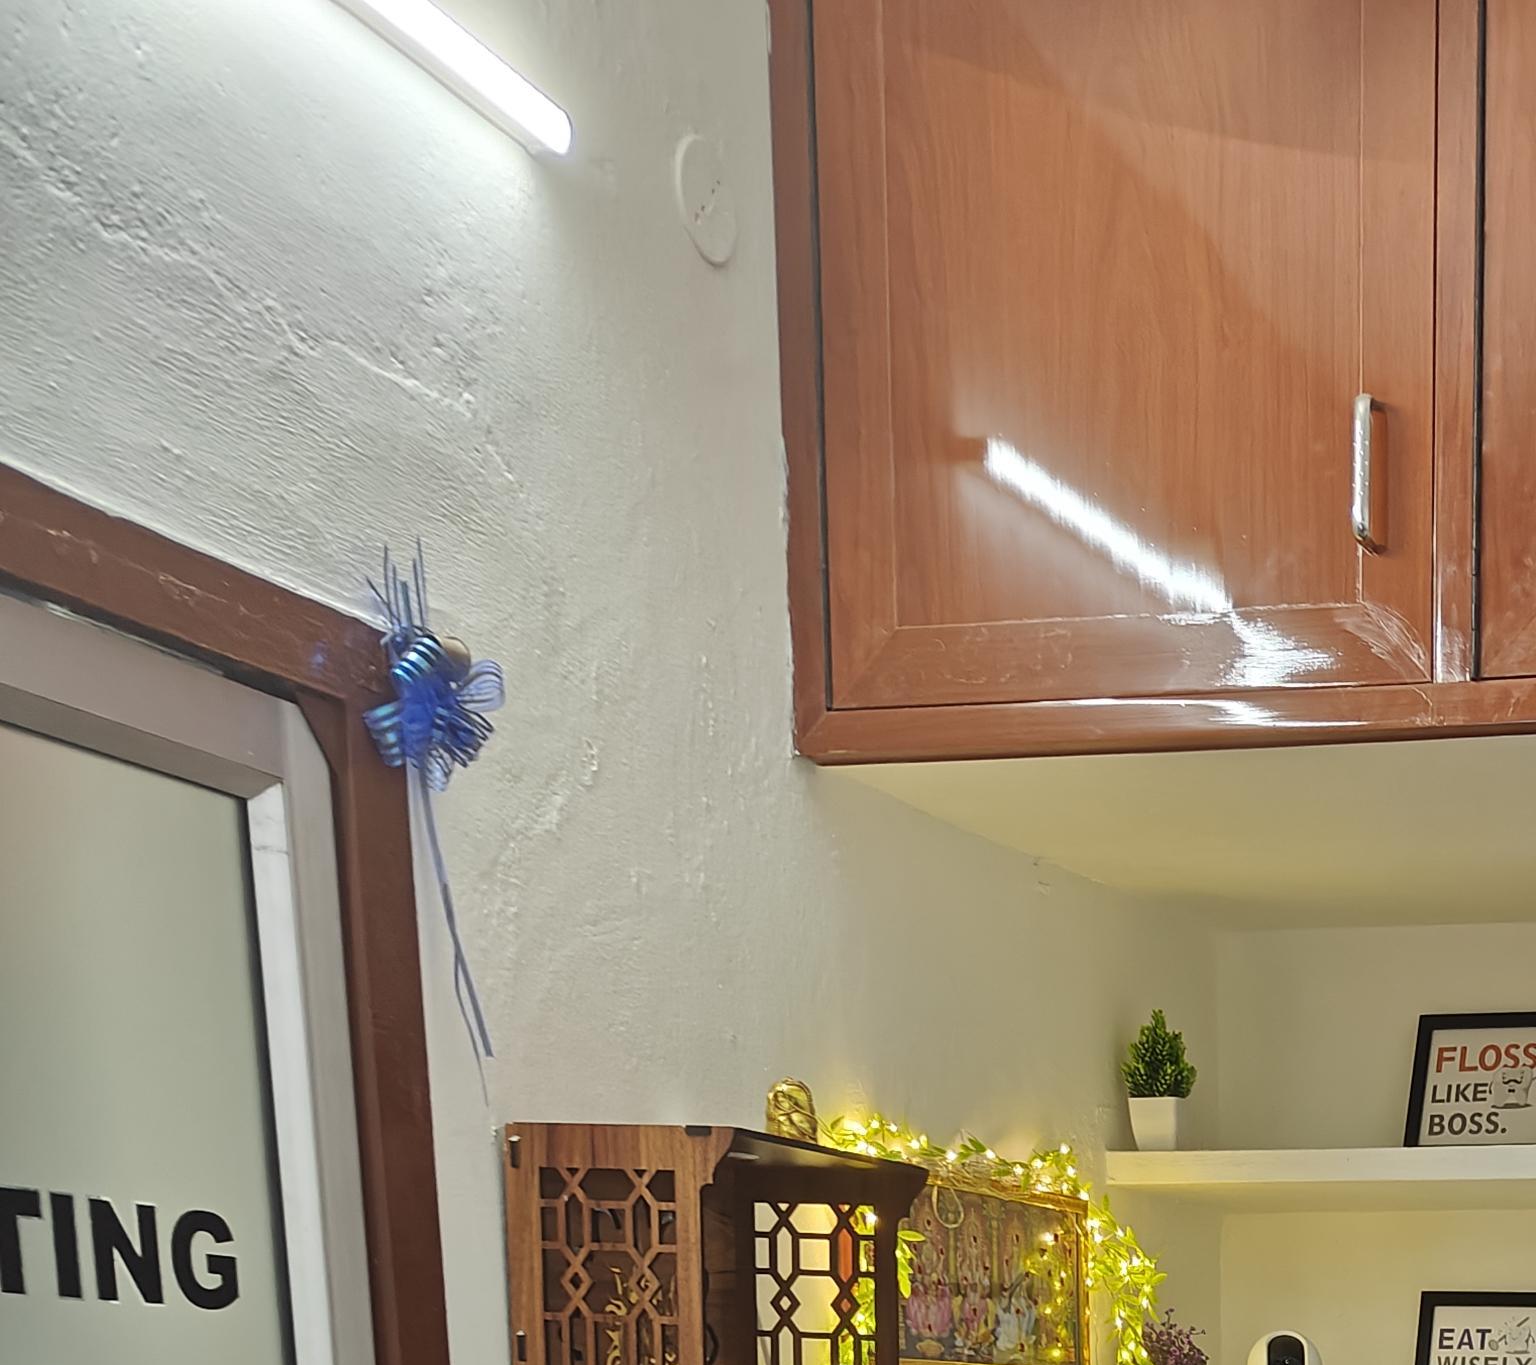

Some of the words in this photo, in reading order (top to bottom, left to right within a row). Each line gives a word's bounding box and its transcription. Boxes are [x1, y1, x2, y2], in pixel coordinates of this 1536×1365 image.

[1431, 1083, 1489, 1104] LIKE
[1428, 1112, 1507, 1136] BOSS.
[1438, 1328, 1492, 1350] EAT
